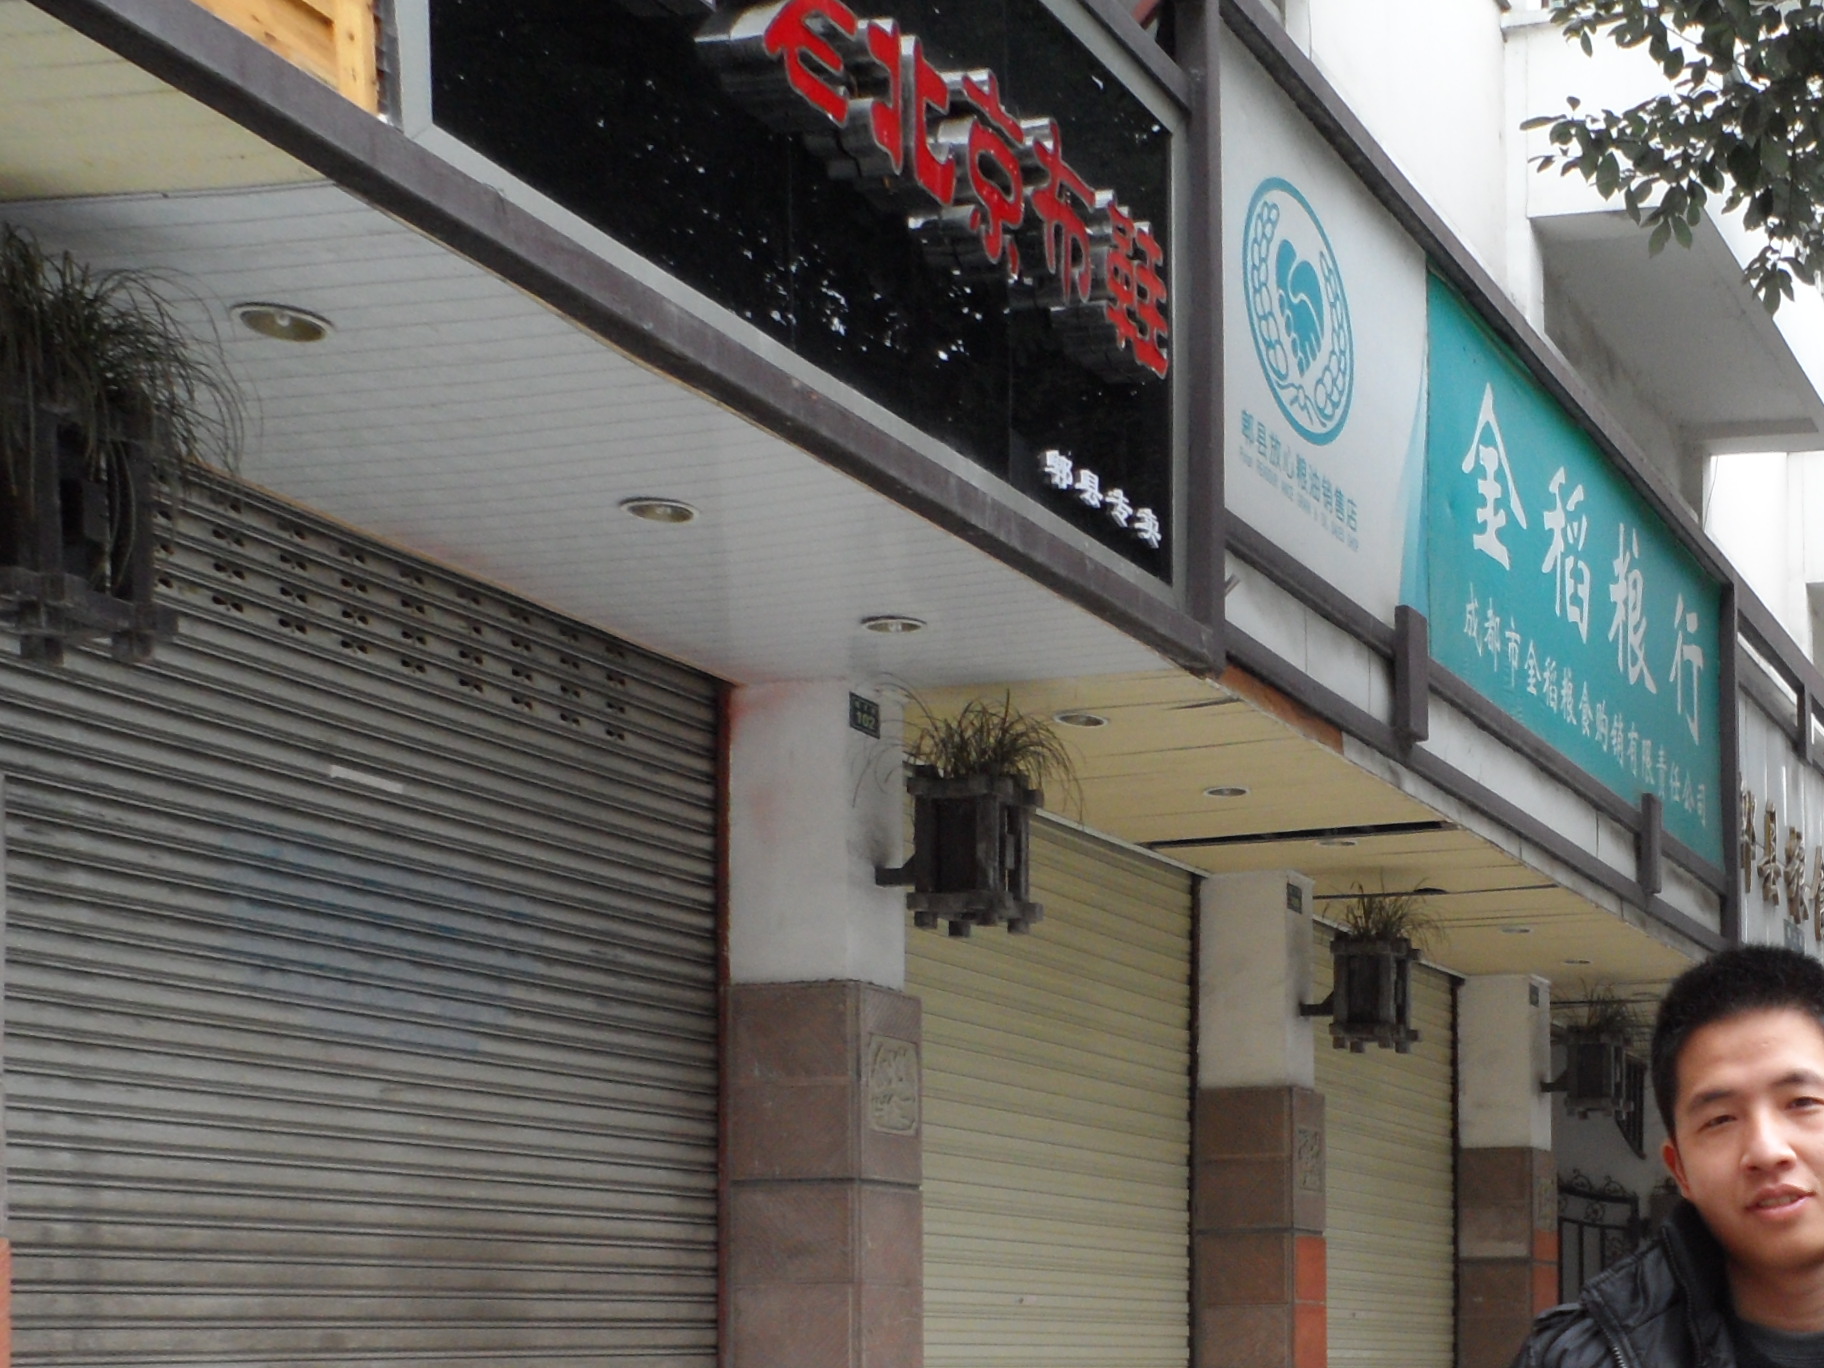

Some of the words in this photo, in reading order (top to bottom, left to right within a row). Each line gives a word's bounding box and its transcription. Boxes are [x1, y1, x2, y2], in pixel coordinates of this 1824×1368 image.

[1462, 382, 1703, 744] 金稻粮行
[1463, 582, 1706, 827] 成都市金稻粮食购销有限责任公司
